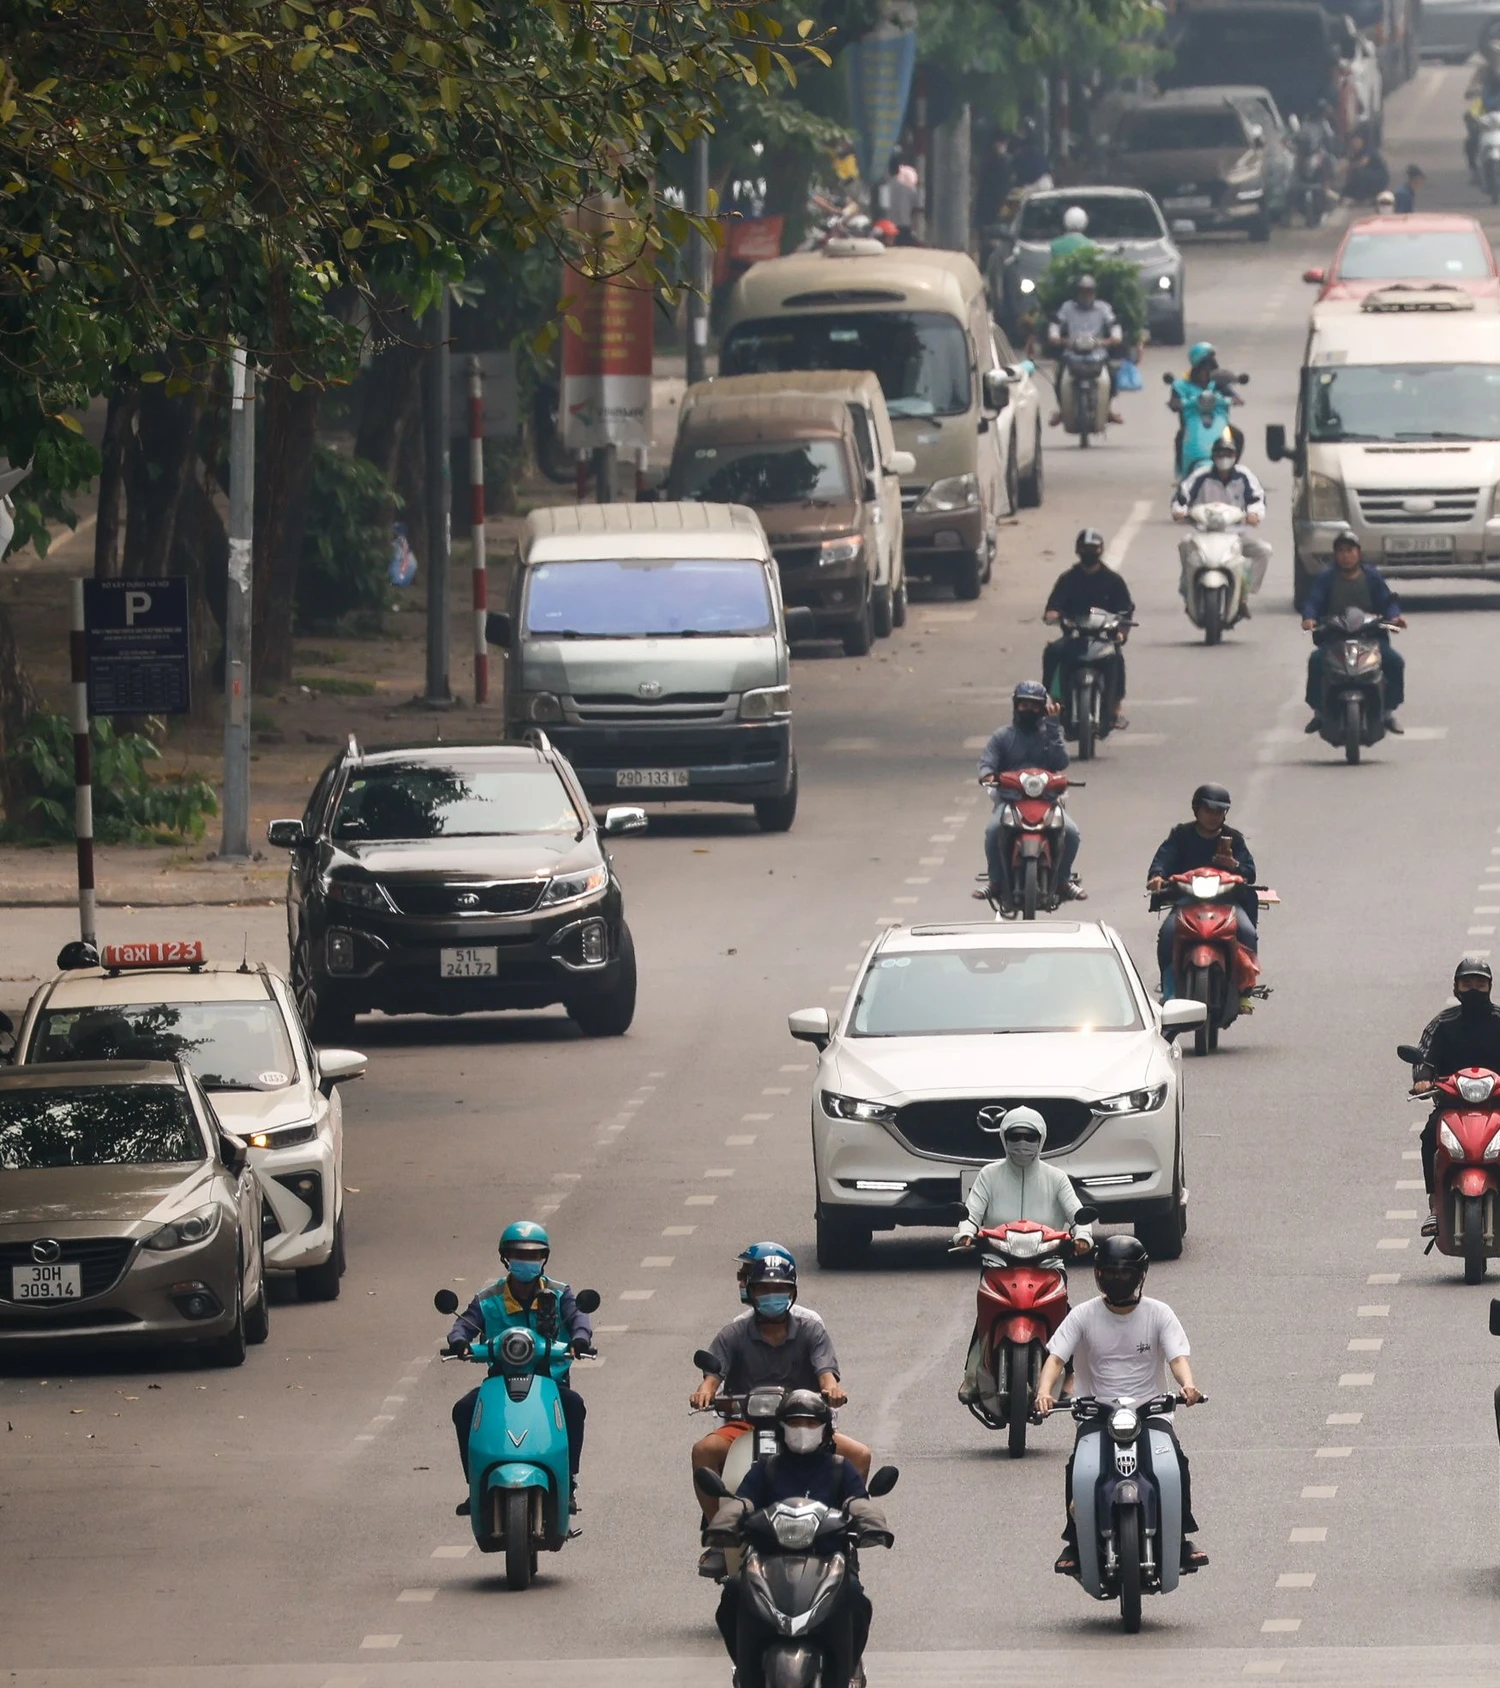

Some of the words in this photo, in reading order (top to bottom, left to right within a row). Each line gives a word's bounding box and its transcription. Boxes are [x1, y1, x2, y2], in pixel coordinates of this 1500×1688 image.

[125, 591, 152, 626] P
[110, 943, 151, 961] Taxi
[156, 941, 197, 961] 123
[456, 949, 480, 962] 51L
[446, 962, 492, 976] 241.72
[32, 1266, 61, 1281] 30H
[20, 1282, 74, 1298] 309.14
